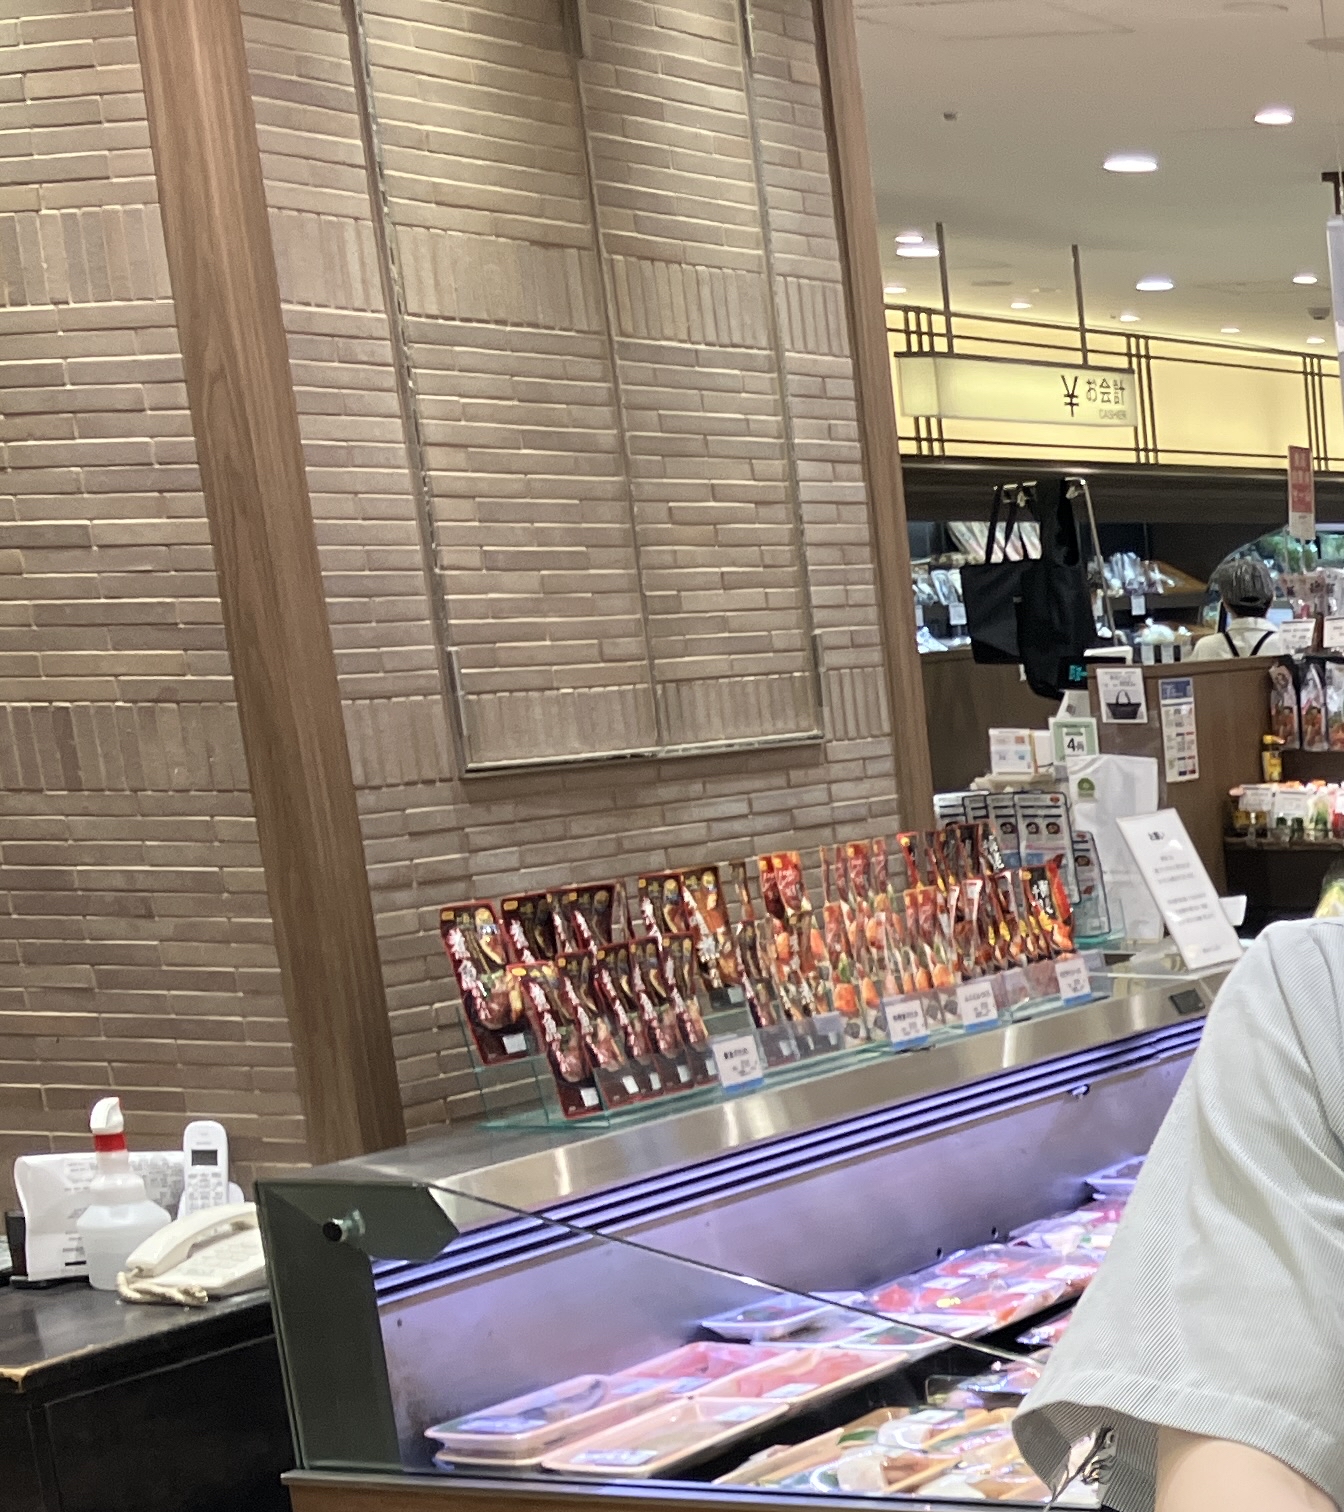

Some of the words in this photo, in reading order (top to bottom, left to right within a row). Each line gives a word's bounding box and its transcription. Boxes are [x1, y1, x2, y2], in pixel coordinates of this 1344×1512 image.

[1086, 378, 1125, 405] お会計
[1098, 409, 1127, 419] CASHIER
